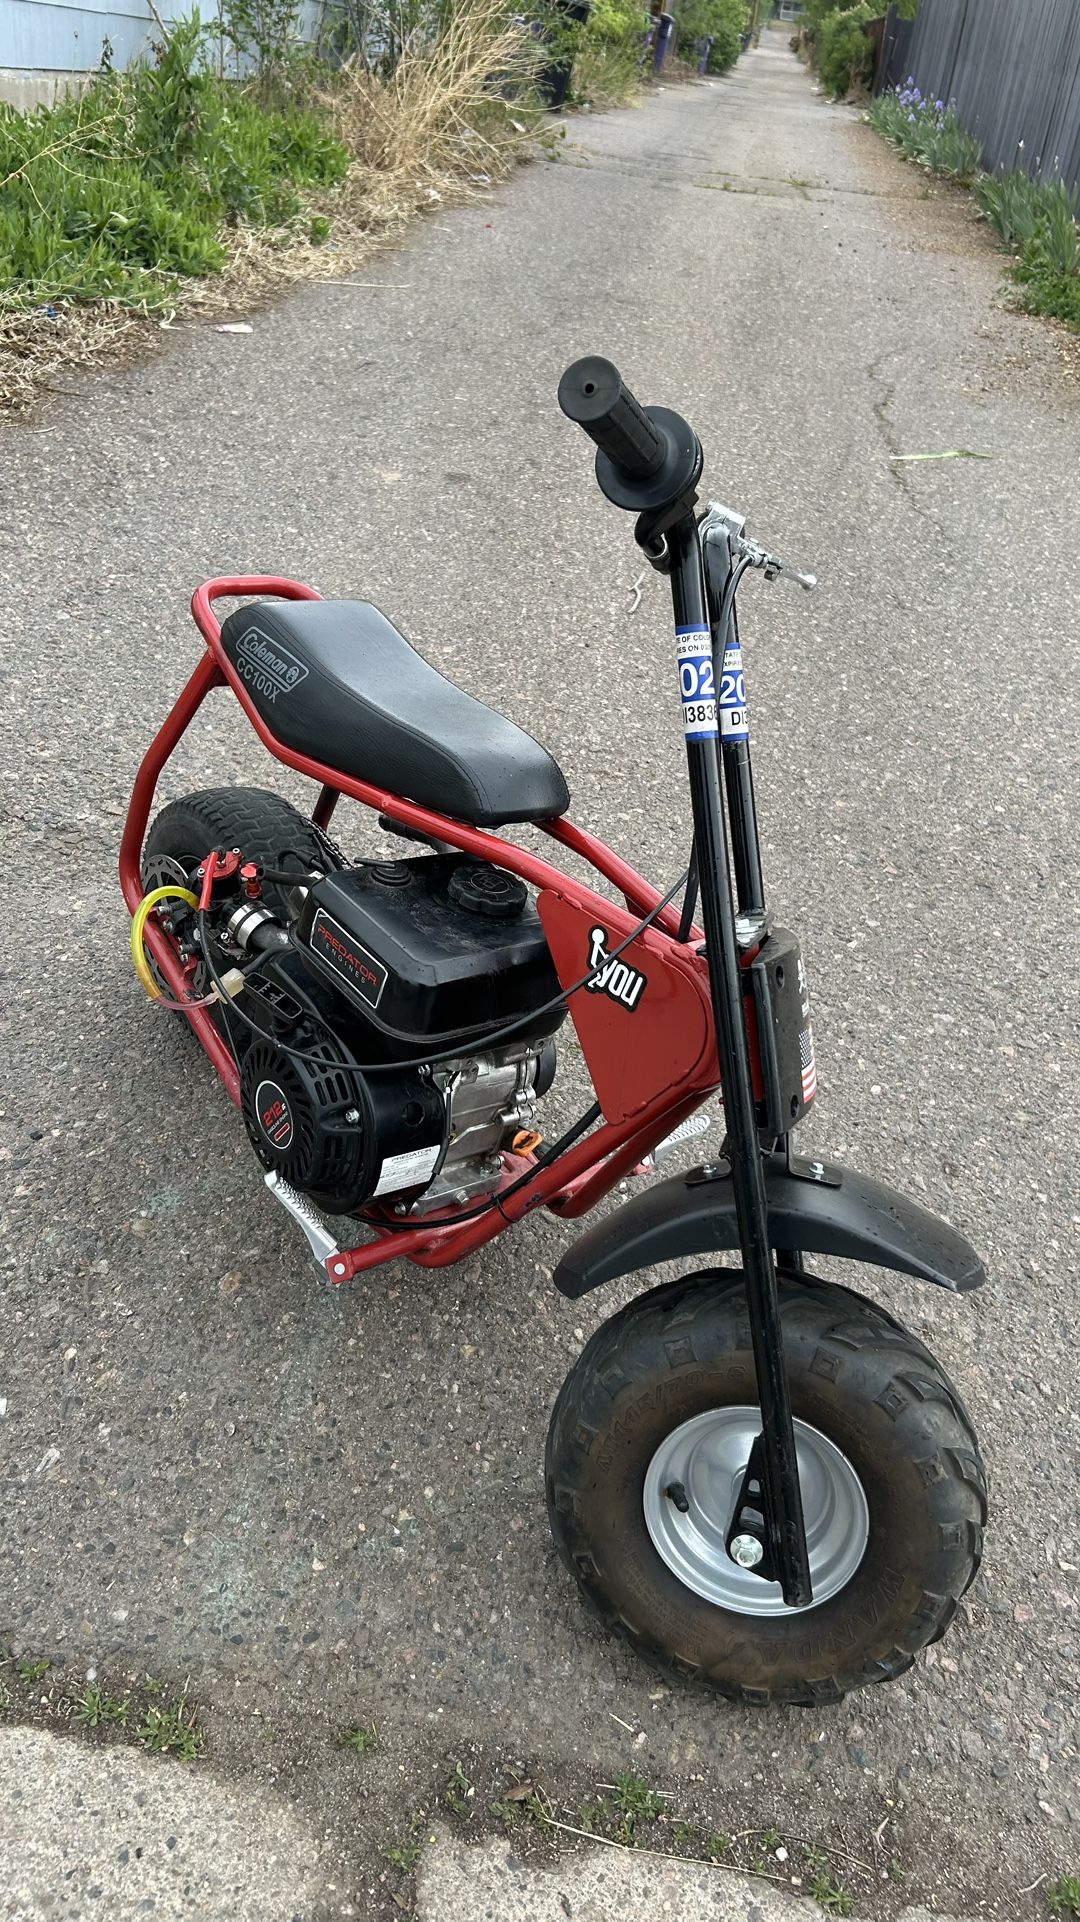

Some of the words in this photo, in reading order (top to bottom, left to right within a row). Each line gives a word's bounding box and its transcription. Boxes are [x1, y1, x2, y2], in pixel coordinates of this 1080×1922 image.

[243, 633, 289, 675] Coleman
[681, 635, 691, 643] OF
[687, 644, 699, 652] ON
[236, 657, 281, 704] CC100X
[680, 660, 715, 697] 02
[318, 923, 377, 987] PREDATOR
